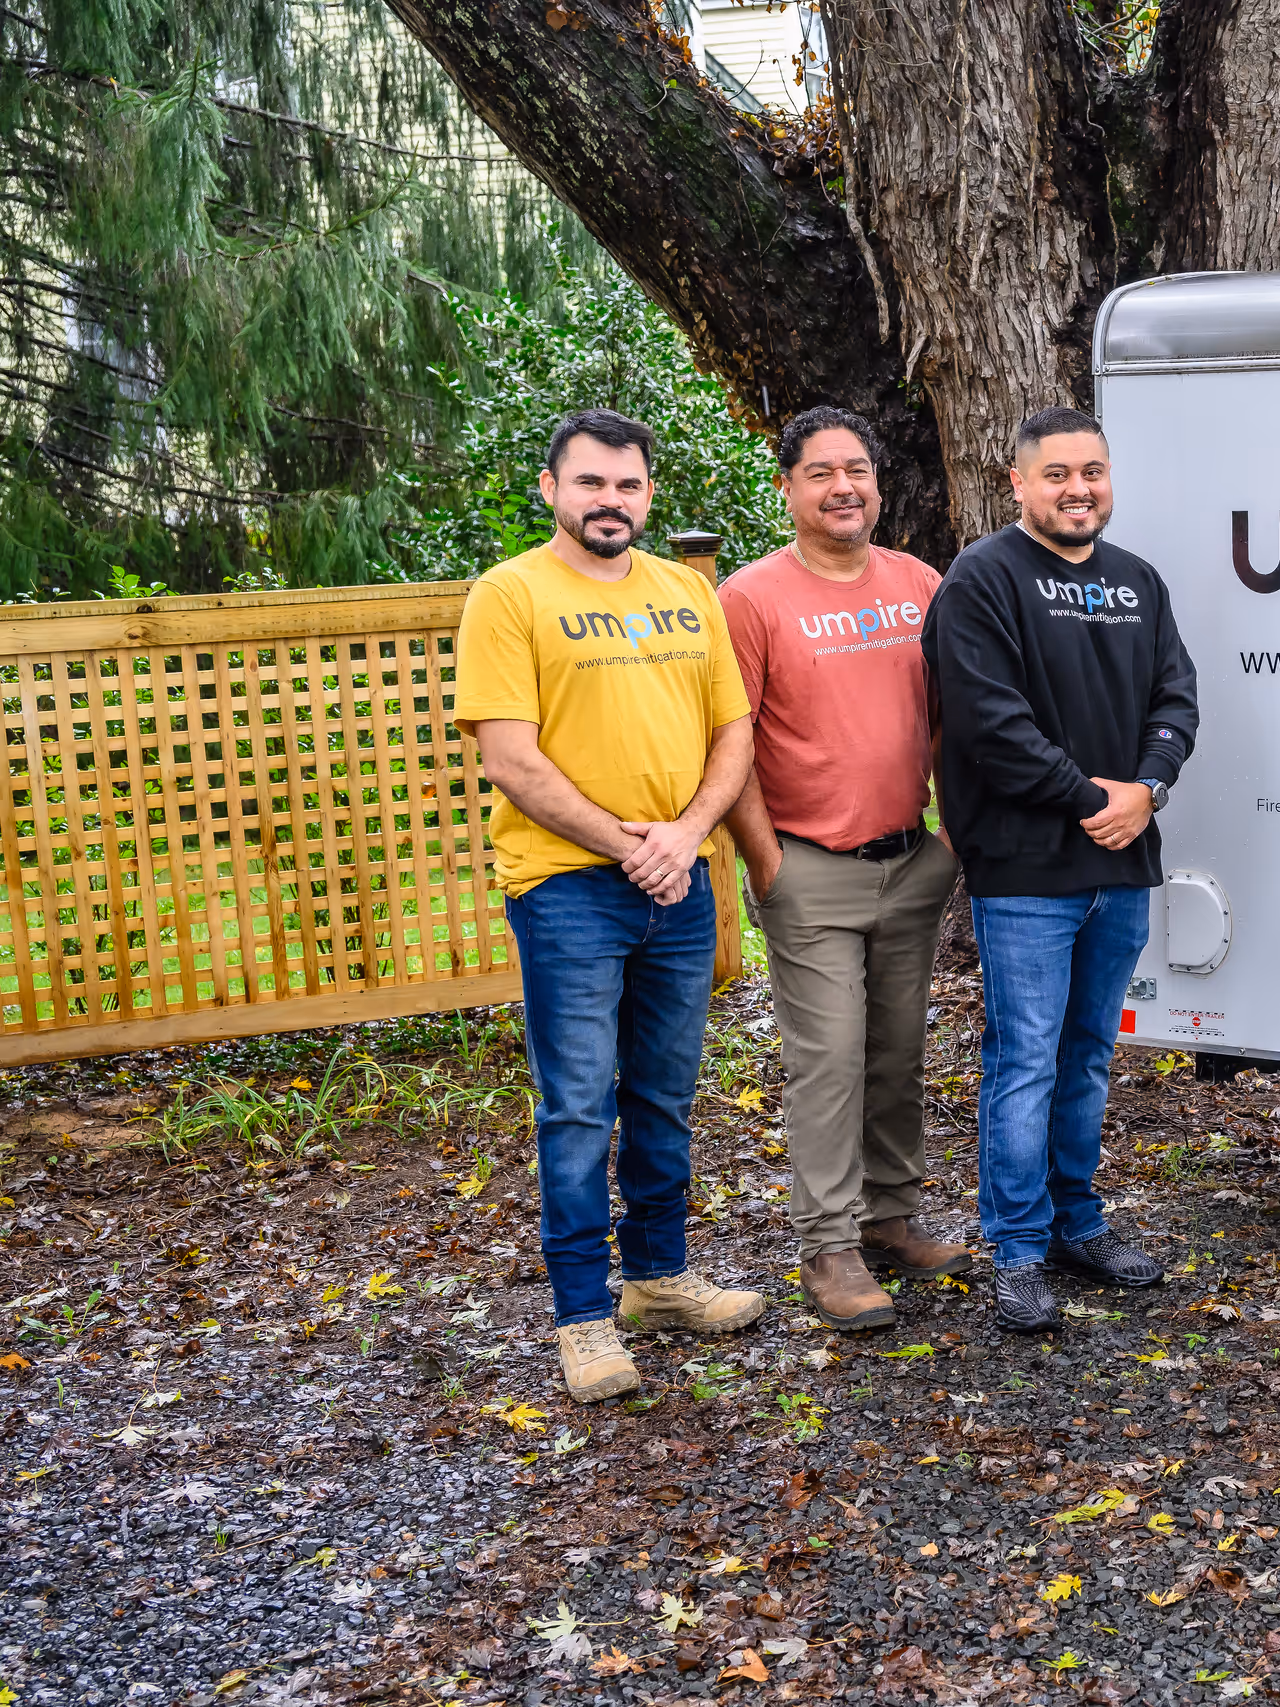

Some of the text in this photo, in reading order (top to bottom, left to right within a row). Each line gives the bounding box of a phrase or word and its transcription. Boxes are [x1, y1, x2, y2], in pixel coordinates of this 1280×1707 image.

[1036, 577, 1139, 613] umpire
[558, 603, 701, 649] umpire
[798, 598, 922, 641] umpire
